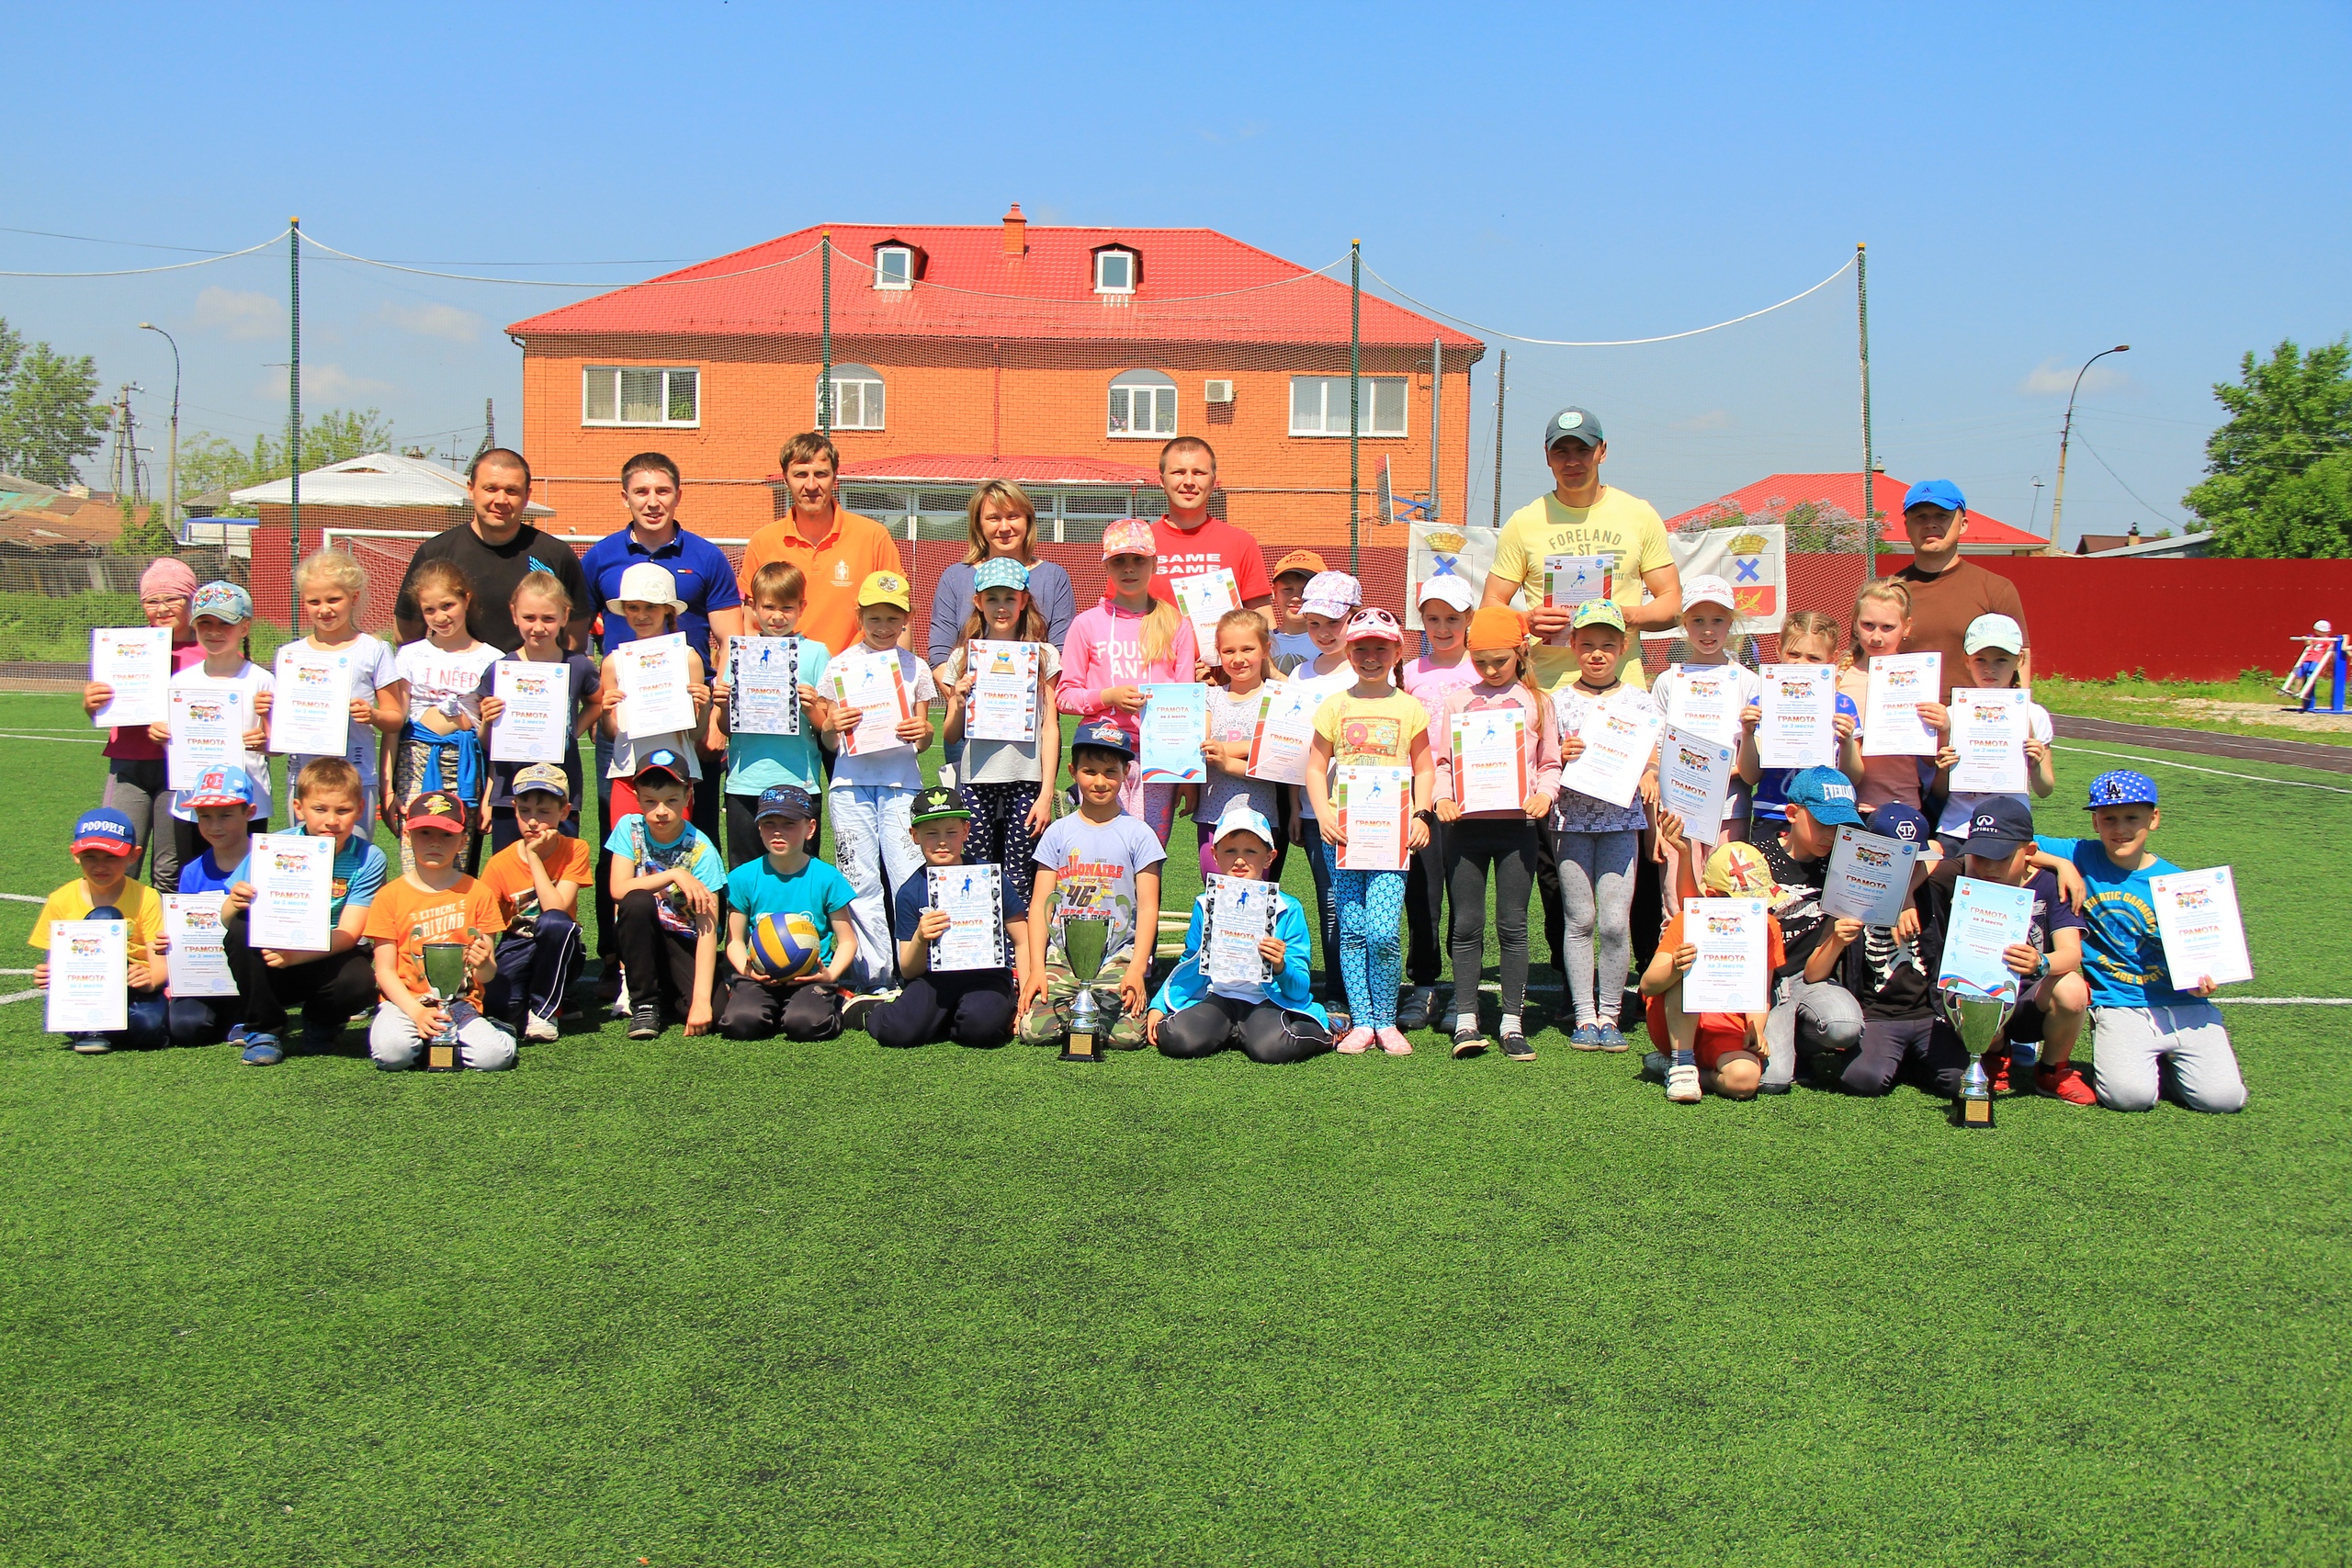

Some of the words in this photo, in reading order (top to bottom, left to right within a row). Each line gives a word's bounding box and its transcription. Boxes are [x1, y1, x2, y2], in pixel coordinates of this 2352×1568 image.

[1548, 528, 1623, 550] FORELAND
[1577, 543, 1591, 557] ST
[1156, 553, 1221, 564] SAME
[1156, 564, 1221, 575] SAME
[424, 667, 431, 684] I
[439, 669, 481, 688] NEED
[639, 682, 673, 693] ГРАМОТА
[746, 687, 781, 695] ГРАМОТА
[984, 692, 1019, 700] ГРАМОТА
[291, 700, 331, 709] ГРАМОТА
[511, 711, 548, 719] ГРАМОТА
[1684, 712, 1722, 721] ГРАМОТА
[187, 738, 227, 746] ГРАМОТА
[1270, 733, 1304, 746] ГРАМОТА
[1283, 743, 1301, 751] место
[1592, 742, 1628, 761] ГРАМОТА
[1471, 761, 1508, 770] ГРАМОТА
[1670, 778, 1708, 798] ГРАМОТА
[2106, 780, 2122, 800] LA
[1685, 793, 1704, 803] место
[927, 803, 952, 813] adidas
[79, 820, 126, 837] РОССИЯ
[1355, 819, 1392, 828] ГРАМОТА
[1846, 874, 1887, 890] ГРАМОТА
[269, 890, 311, 900] ГРАМОТА
[1066, 884, 1097, 908] 46
[1862, 886, 1883, 895] место
[419, 903, 457, 921] EXTREME
[1970, 907, 2008, 921] ГРАМОТА
[2121, 891, 2157, 934] GARMENS
[1219, 929, 1256, 940] ГРАМОТА
[2178, 924, 2221, 937] ГРАМОТА
[1703, 953, 1746, 962] ГРАМОТА
[66, 974, 107, 982] ГРАМОТА
